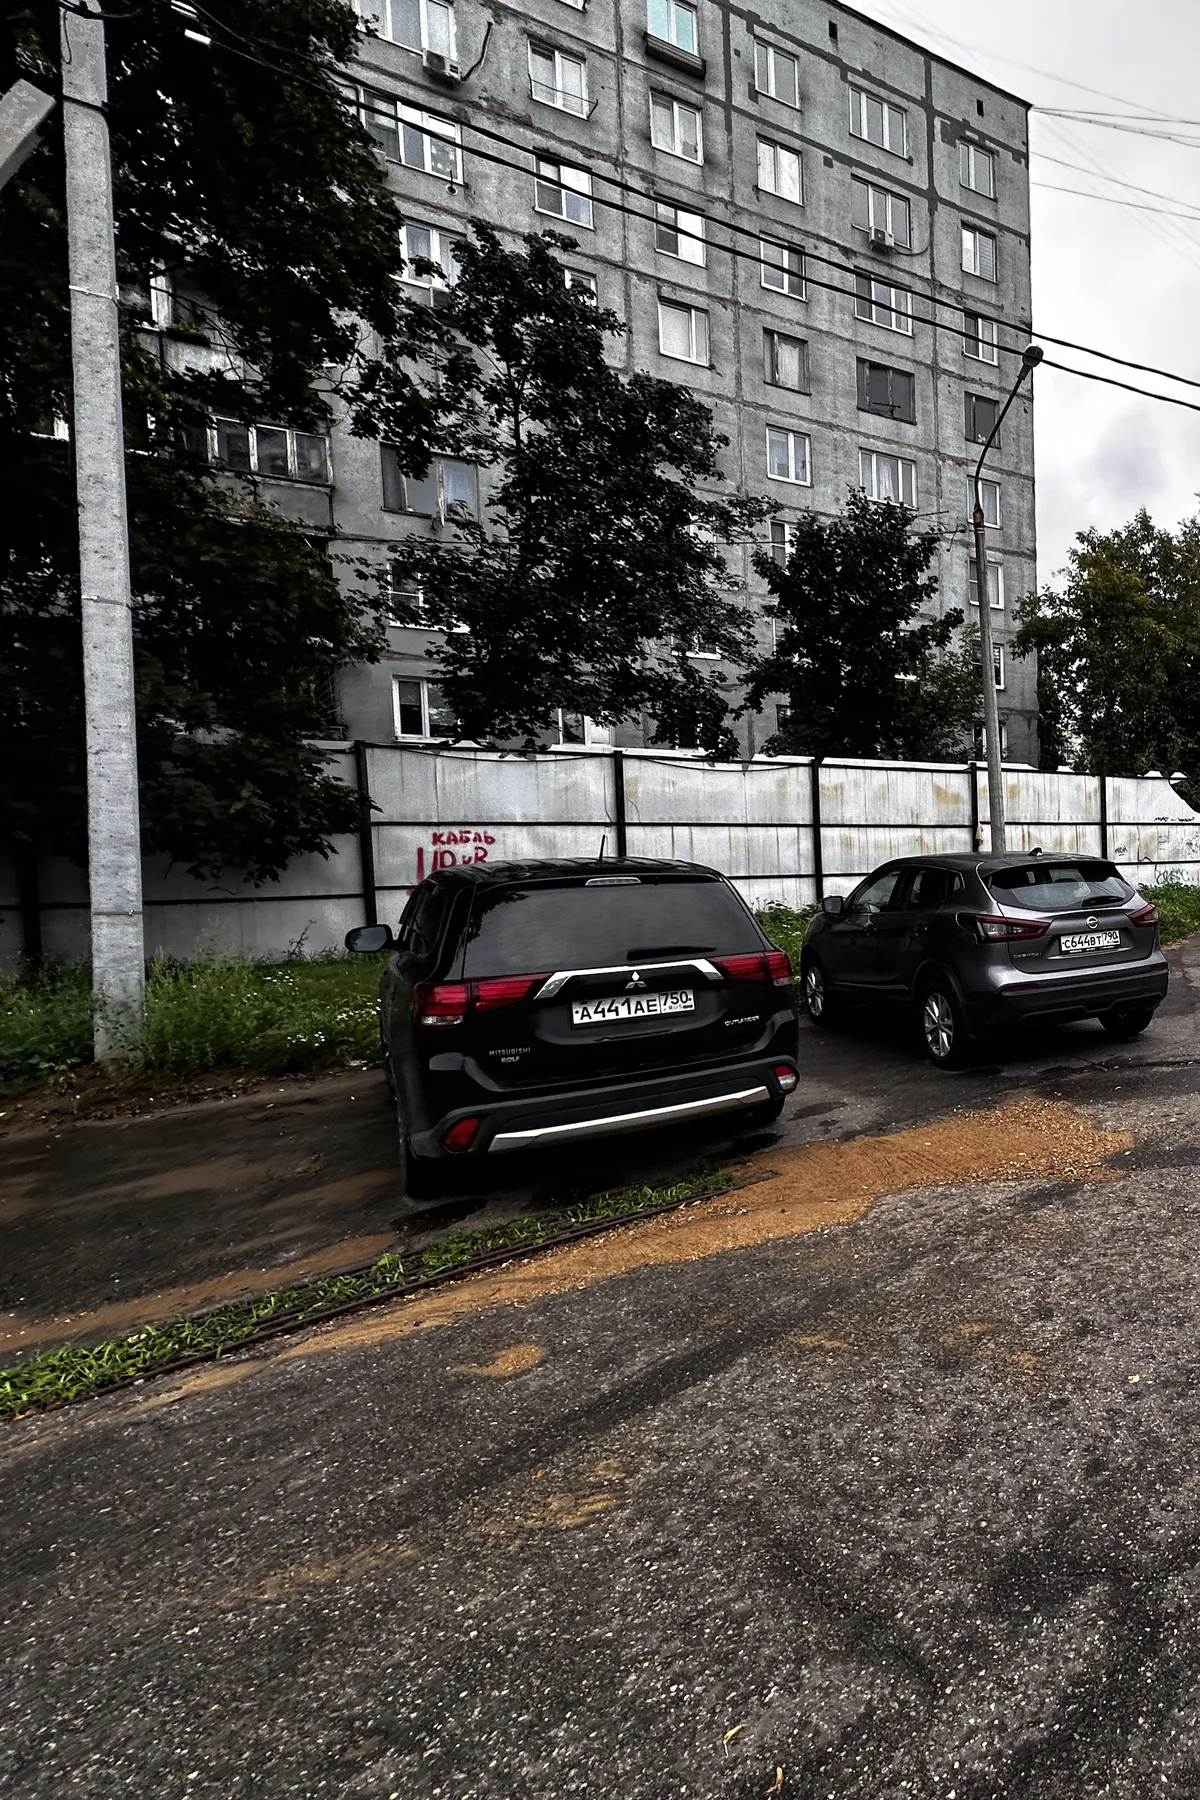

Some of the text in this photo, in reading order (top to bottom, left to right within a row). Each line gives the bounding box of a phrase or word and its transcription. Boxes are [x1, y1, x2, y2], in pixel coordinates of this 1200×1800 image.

[580, 991, 689, 1021] А441АЕ 750
[488, 1047, 531, 1057] MITSUBISHI
